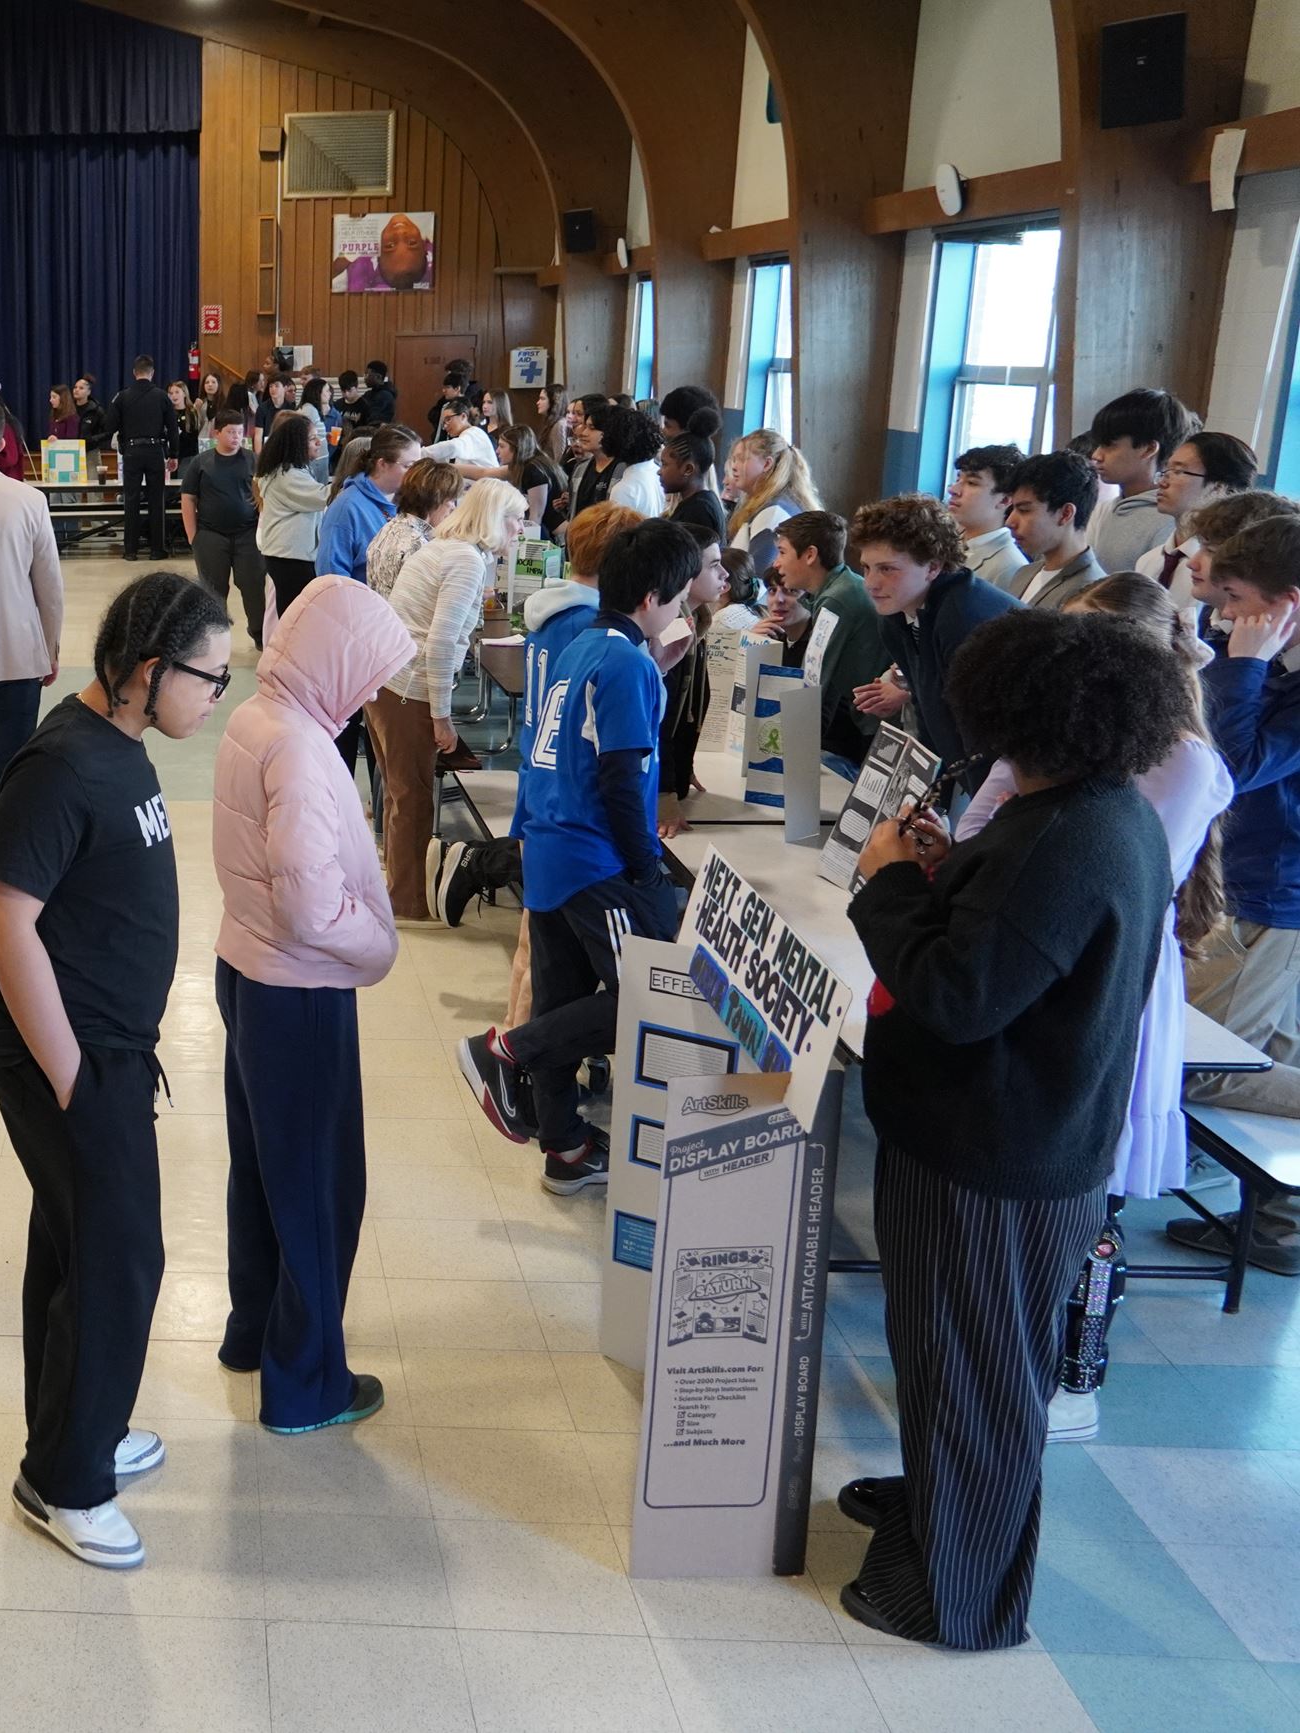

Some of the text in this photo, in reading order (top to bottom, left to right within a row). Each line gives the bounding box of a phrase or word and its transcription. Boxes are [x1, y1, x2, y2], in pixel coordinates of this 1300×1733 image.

[342, 243, 379, 252] PURPLE
[134, 793, 171, 847] ME
[703, 854, 741, 915] NEXT
[740, 891, 775, 951] GEN
[772, 925, 837, 1027] MENTAL
[695, 895, 748, 974] HEALTH
[745, 948, 814, 1056] SOCIETY
[682, 1095, 749, 1112] ArtSkills
[669, 1139, 740, 1172] DISPLAY
[744, 1122, 805, 1151] BOARD
[669, 1139, 704, 1156] Project
[703, 1153, 769, 1177] WITH HEADER
[808, 1168, 824, 1222] HEADER
[701, 1250, 749, 1268] RINGS
[802, 1226, 819, 1310] ATTACHABLE
[696, 1276, 752, 1298] SATURN
[667, 1367, 686, 1375] Visit
[688, 1366, 745, 1374] ArtSkills.com
[798, 1356, 810, 1392] BOARD
[794, 1395, 806, 1436] DISPLAY
[721, 1438, 745, 1446] More
